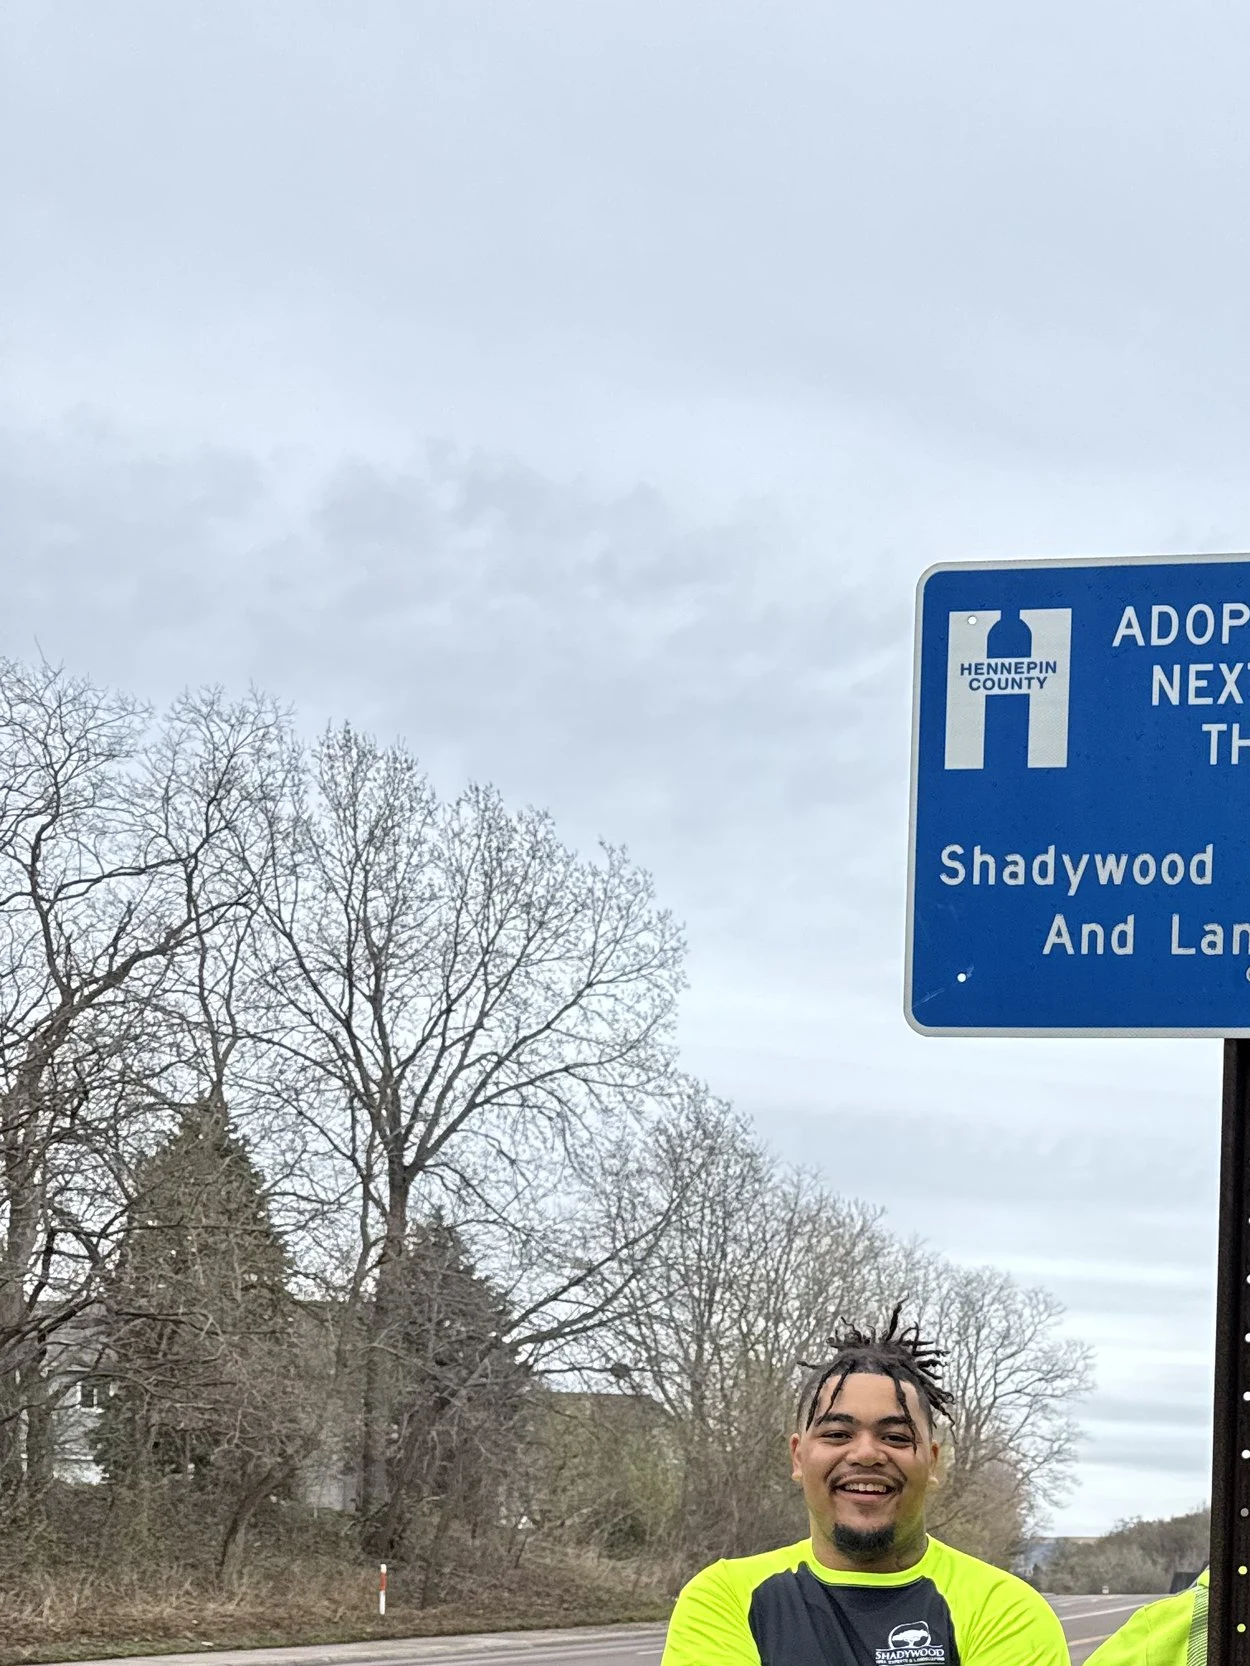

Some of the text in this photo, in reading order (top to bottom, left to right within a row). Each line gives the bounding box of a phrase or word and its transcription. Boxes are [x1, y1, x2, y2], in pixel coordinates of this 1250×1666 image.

[960, 660, 1057, 676] HENNEPIN
[968, 676, 1048, 691] COUNTY
[939, 842, 1214, 896] Shadywood
[1042, 913, 1135, 955] And
[875, 1648, 945, 1660] SHADYWOOD
